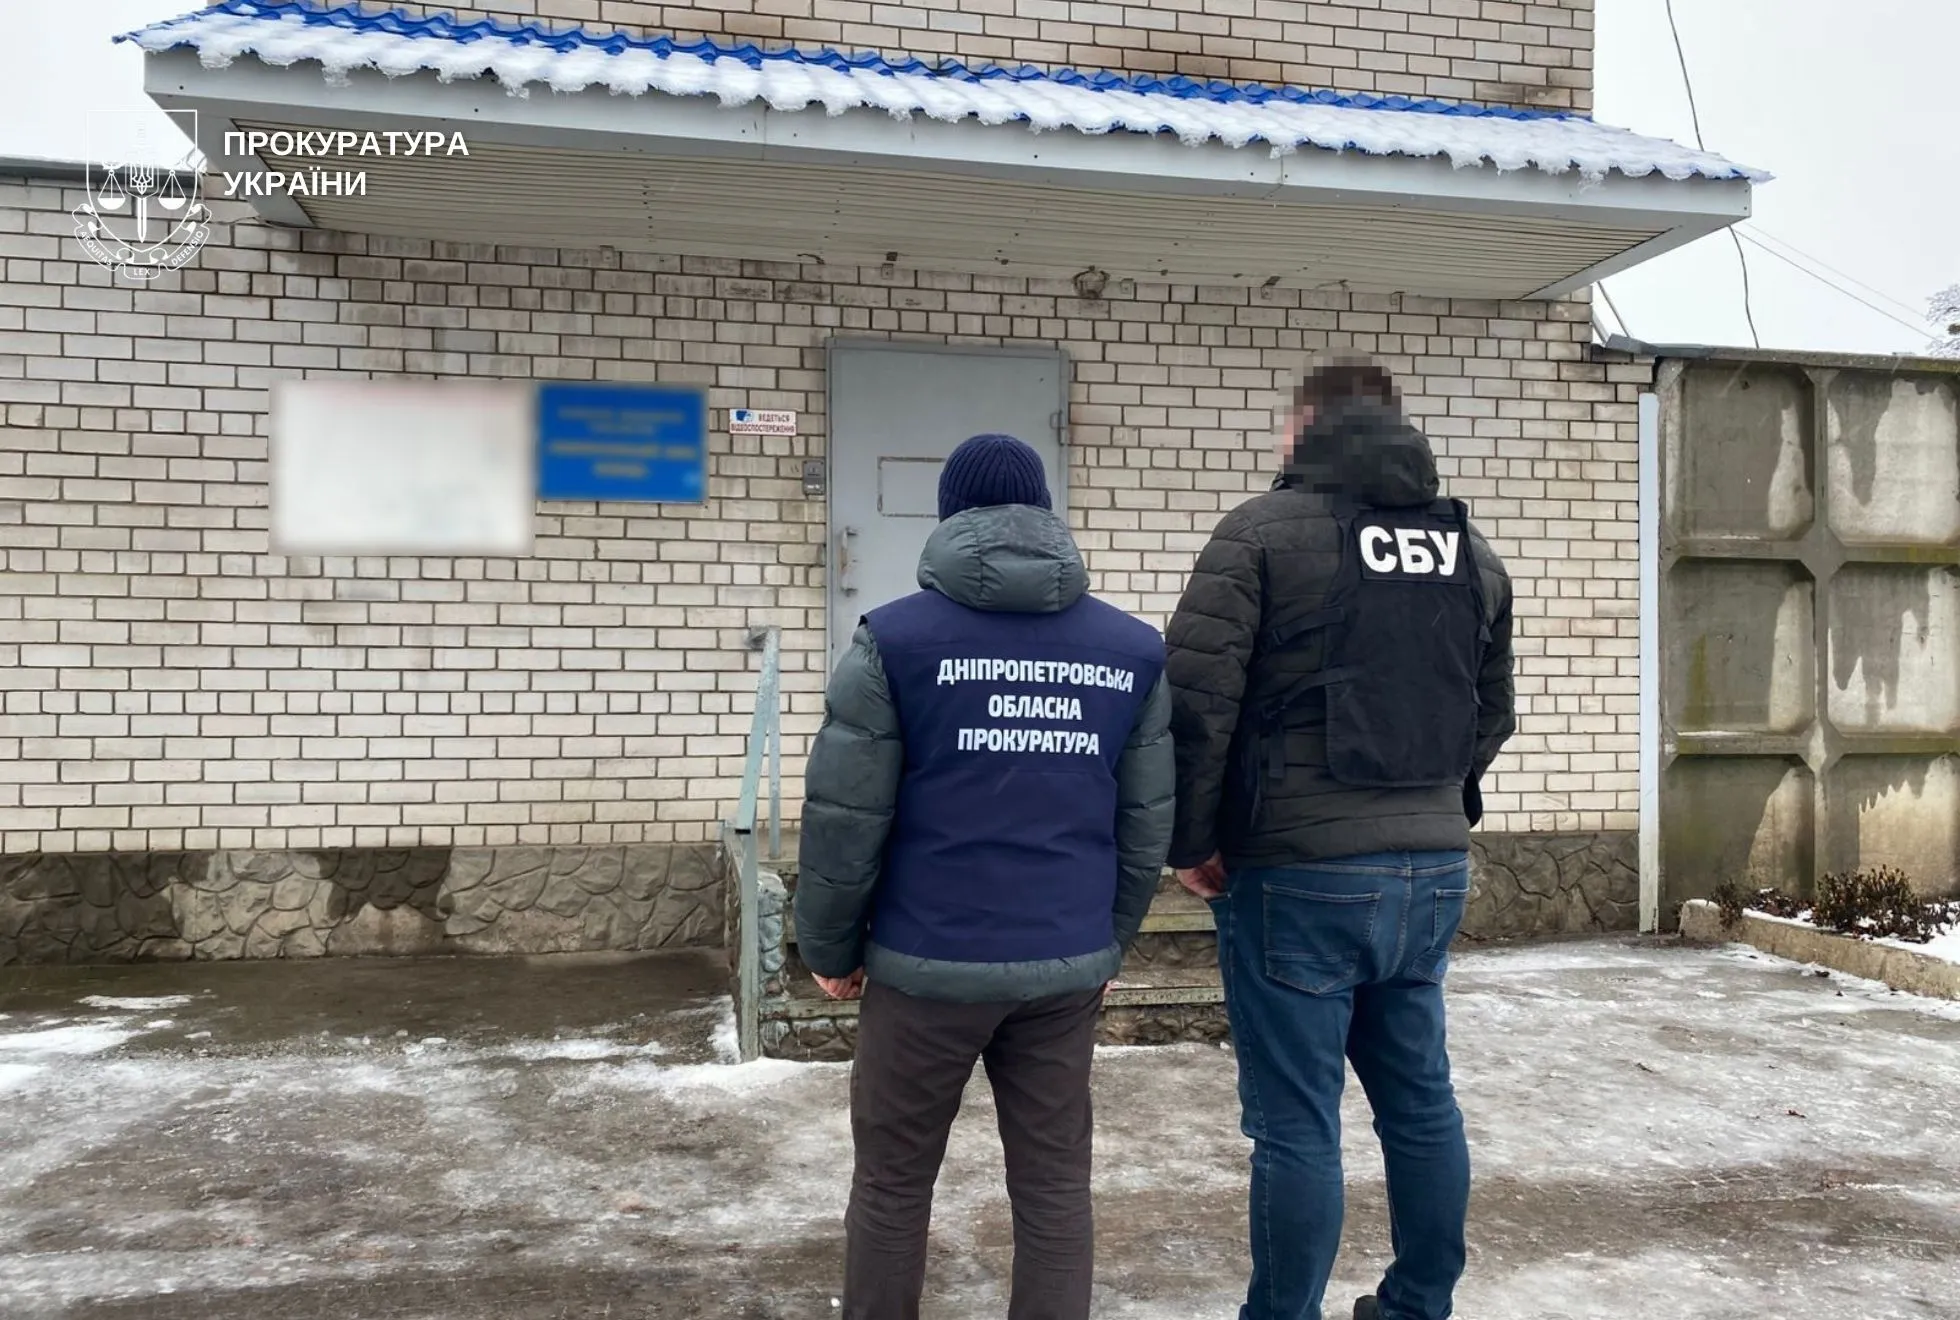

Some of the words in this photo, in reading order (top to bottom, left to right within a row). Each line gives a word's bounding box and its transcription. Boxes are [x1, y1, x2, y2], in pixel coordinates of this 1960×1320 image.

[731, 423, 795, 434] ВІДЕОСПОСТЕРЕЖЕННЯ
[758, 413, 791, 423] ВЕДЕТЬСЯ
[1360, 525, 1460, 576] СБУ
[937, 658, 1135, 693] ДНІПРОПЕТРОВСЬКА
[988, 694, 1083, 720] ОБЛАСНА
[957, 728, 1100, 756] ПРОКУРАТУРА
